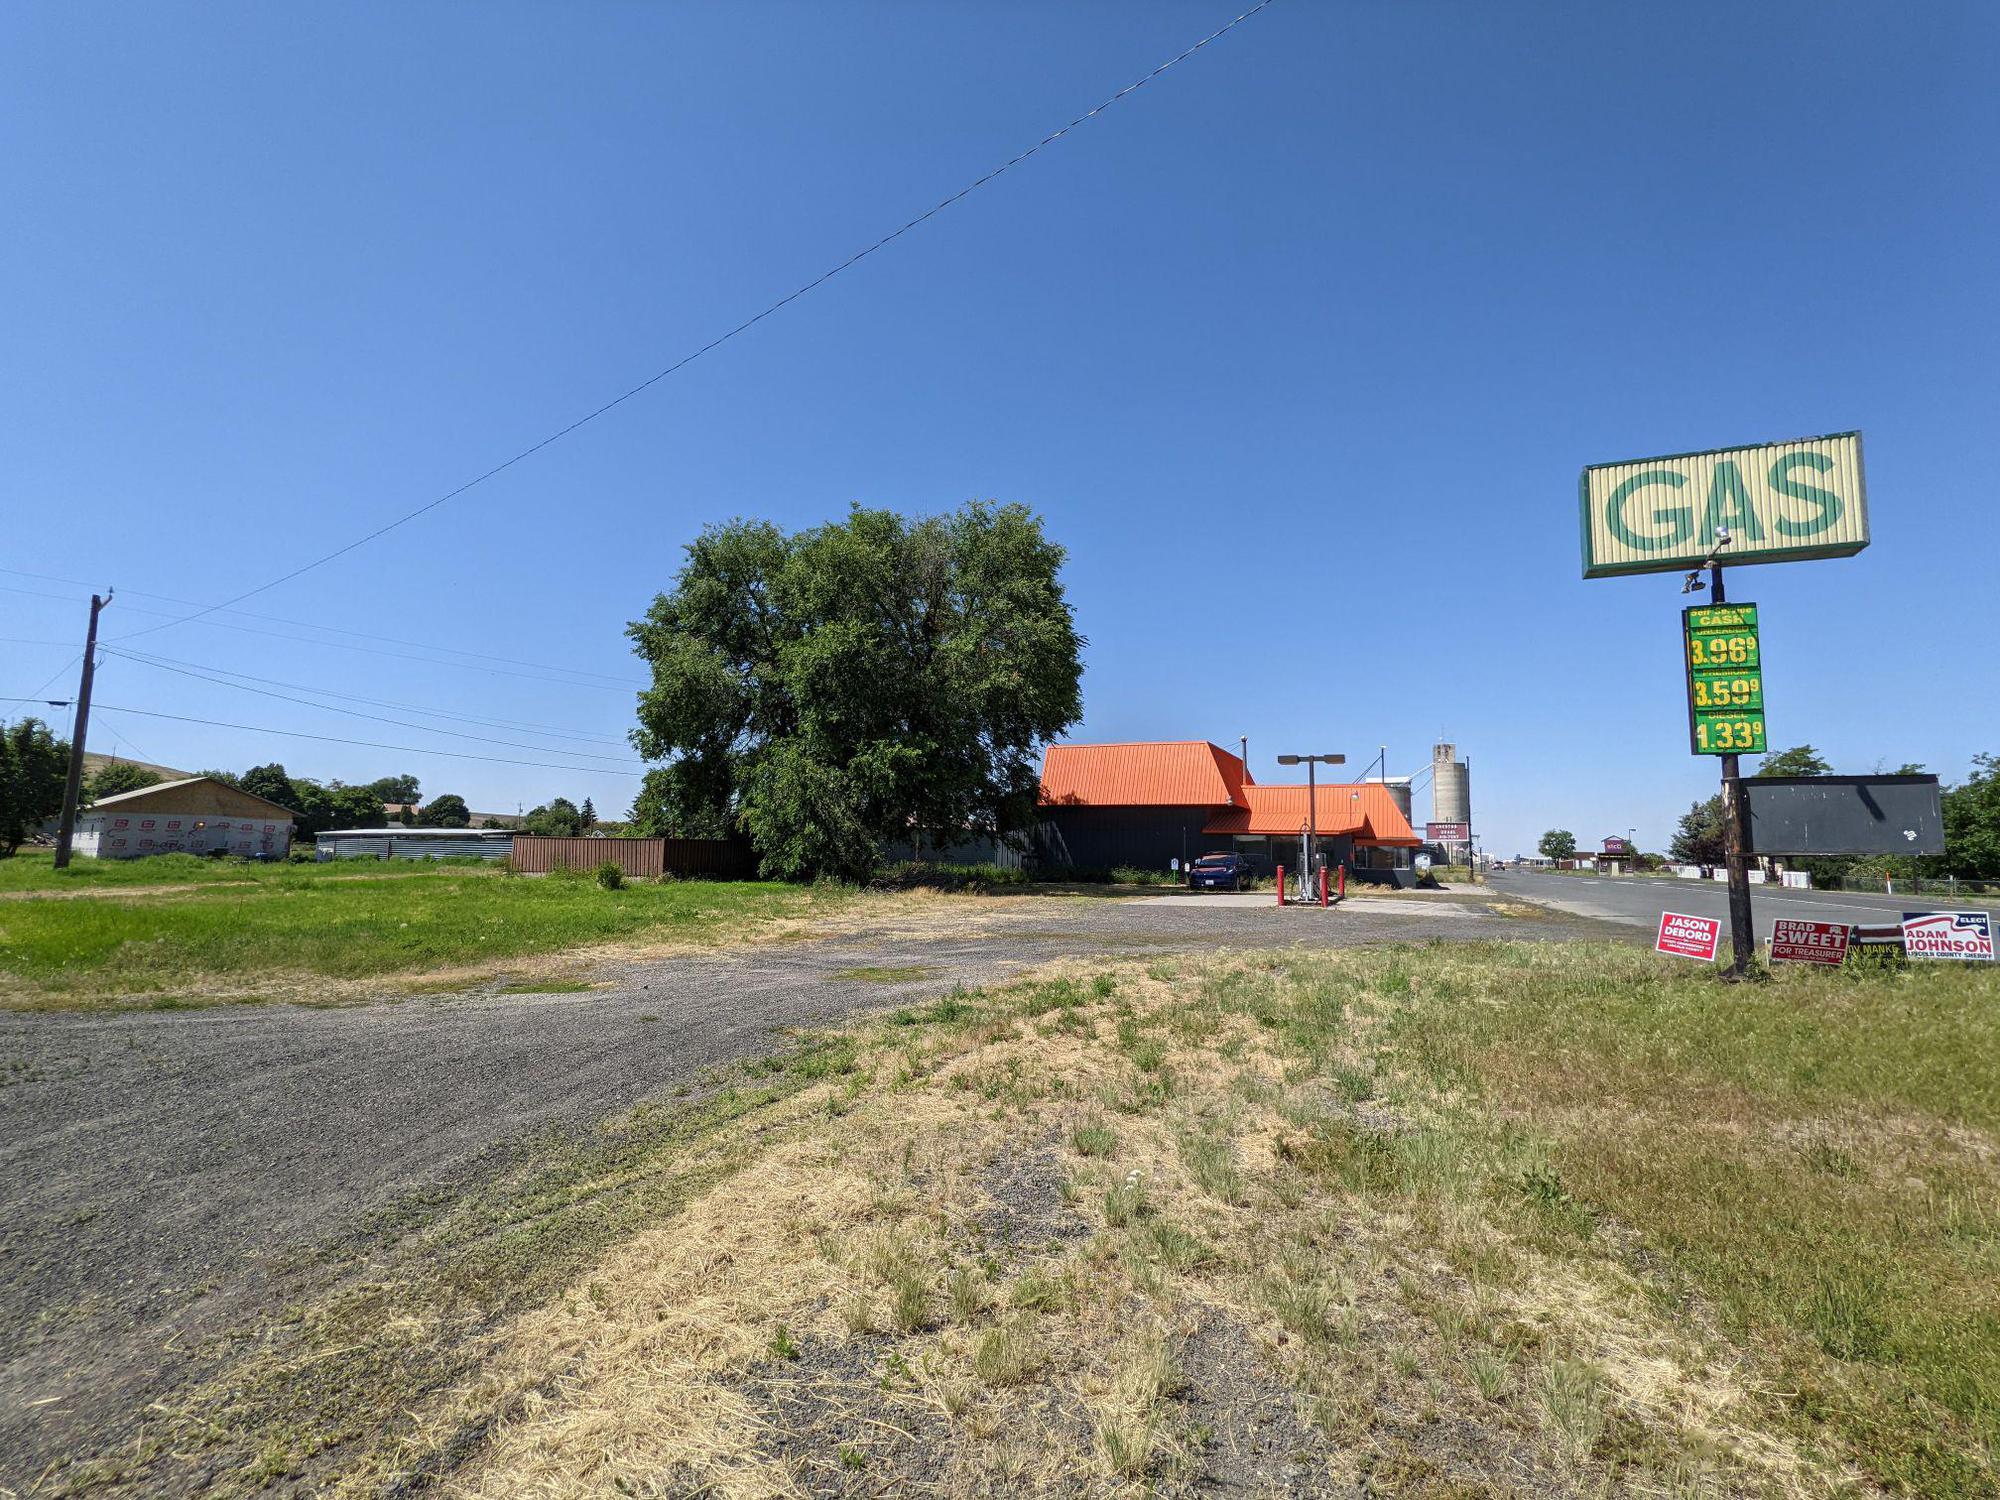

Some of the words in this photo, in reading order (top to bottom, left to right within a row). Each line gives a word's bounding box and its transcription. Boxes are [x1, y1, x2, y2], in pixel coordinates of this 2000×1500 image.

[1606, 451, 1843, 552] GAS
[1699, 615, 1745, 625] CASH
[1692, 637, 1747, 664] 3.96
[1695, 679, 1750, 706] 3.59
[1708, 711, 1748, 720] DIESEL
[1669, 917, 1710, 931] JASON
[1778, 921, 1816, 932] BRAD
[1664, 926, 1711, 942] DEBORD
[1776, 930, 1845, 948] SWEET
[1906, 930, 1948, 939] ADAM
[1774, 946, 1792, 954] FOR
[1794, 947, 1843, 959] TREASURER
[1907, 939, 1992, 953] JOHNSON
